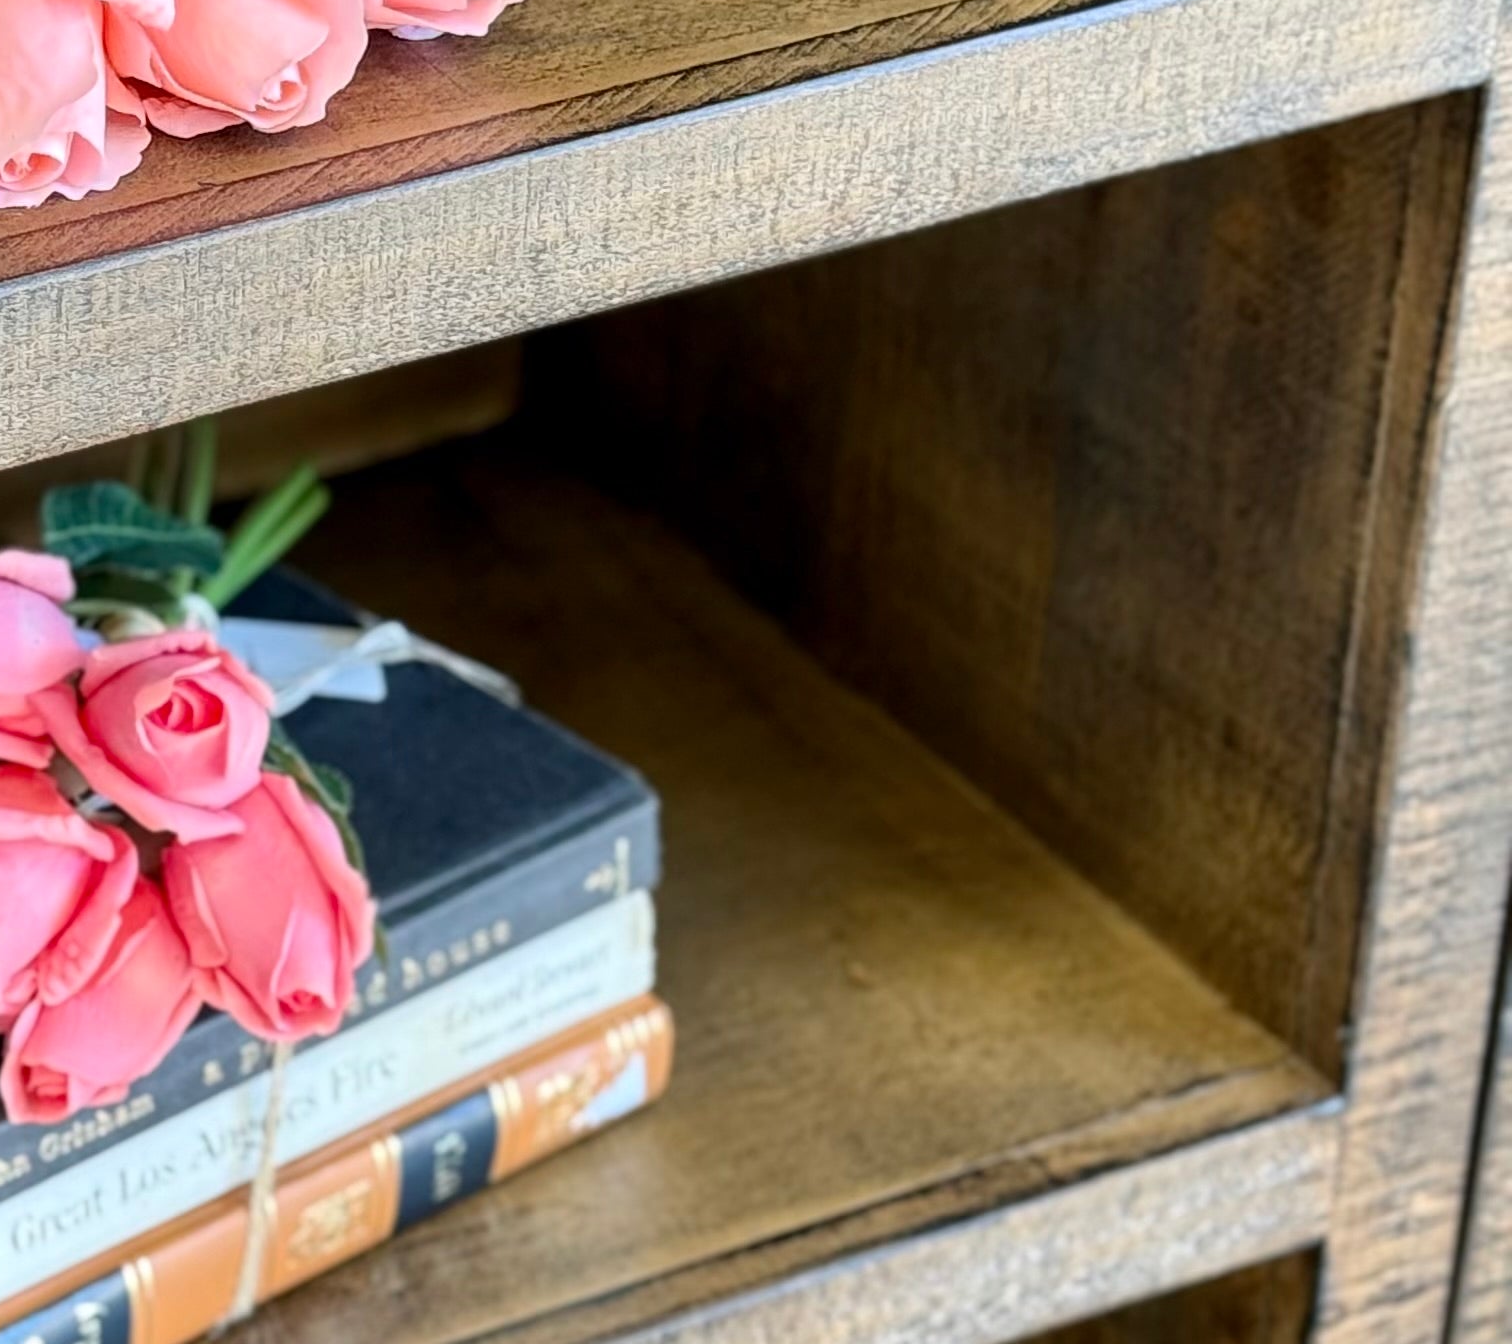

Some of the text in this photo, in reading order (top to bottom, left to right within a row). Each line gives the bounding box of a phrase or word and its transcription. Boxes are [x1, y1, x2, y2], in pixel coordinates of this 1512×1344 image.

[400, 919, 512, 990] house
[8, 1183, 106, 1258] Great
[117, 1157, 178, 1206] Los
[189, 1086, 321, 1169] Anges
[330, 1049, 401, 1104] Fire
[37, 1093, 156, 1163] Grisham
